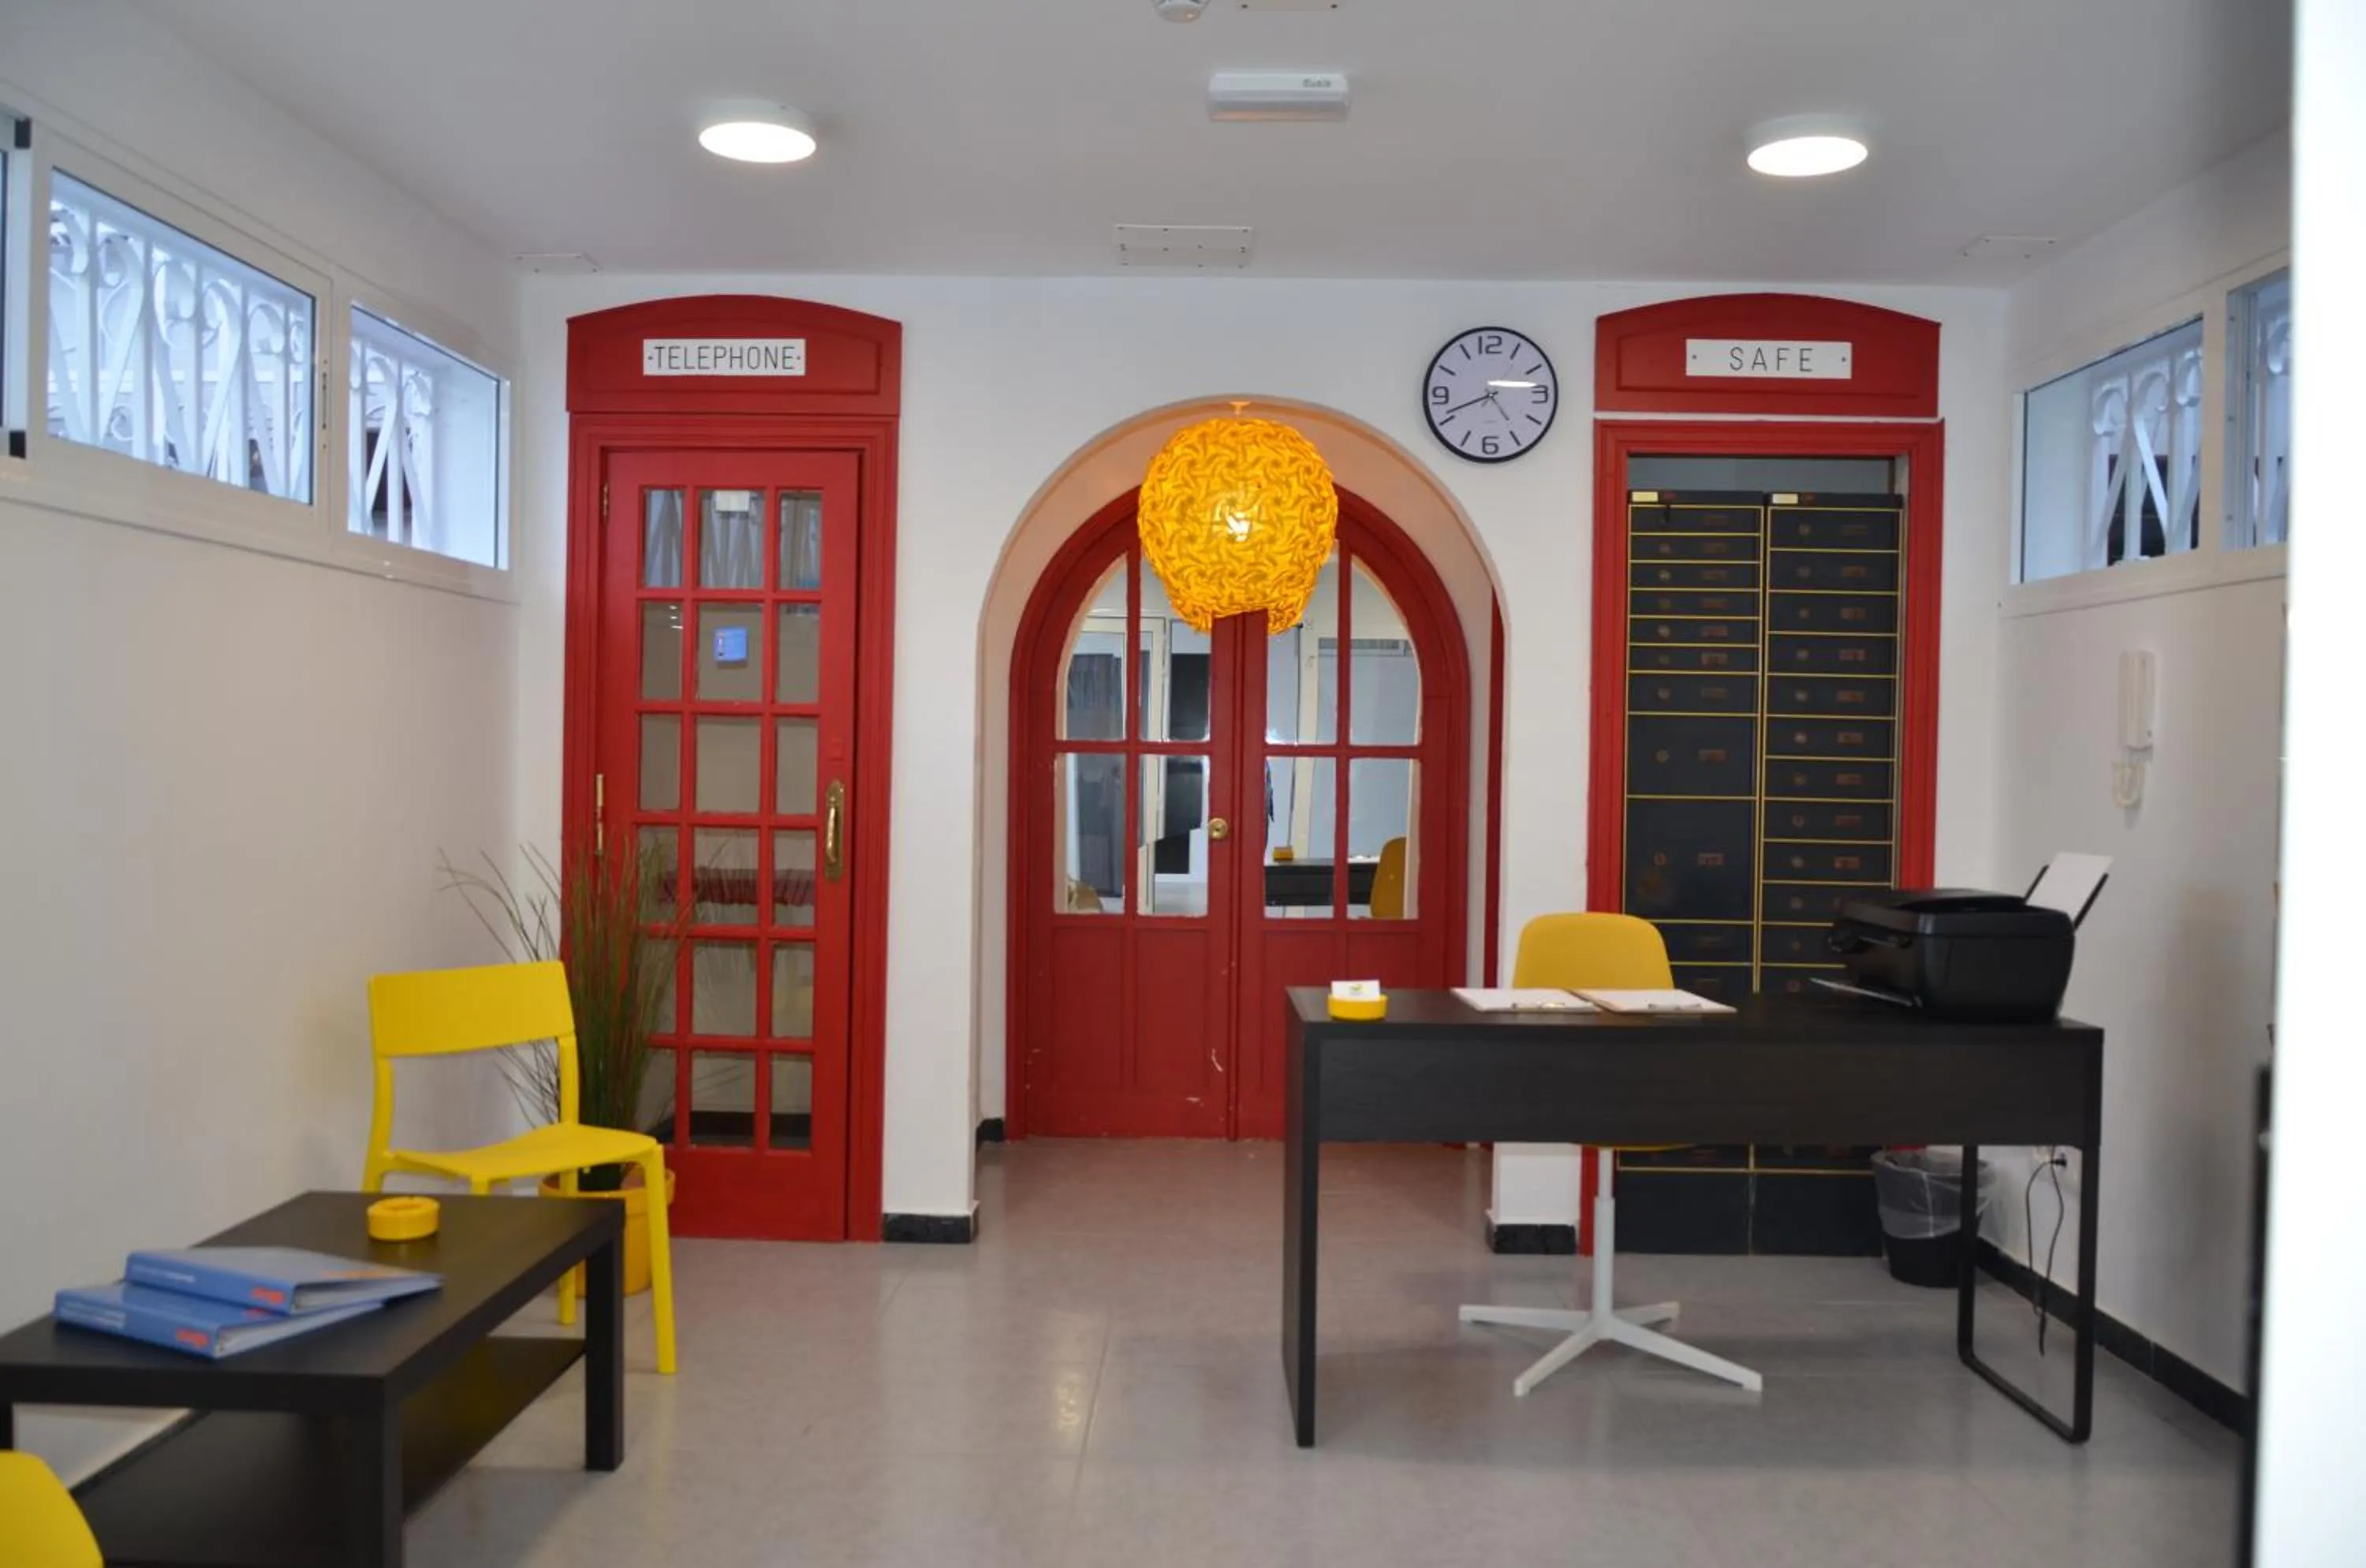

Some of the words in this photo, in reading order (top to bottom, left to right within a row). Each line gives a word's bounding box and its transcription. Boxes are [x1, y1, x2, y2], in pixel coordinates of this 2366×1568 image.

[1478, 335, 1502, 354] 12
[653, 345, 796, 370] TELEPHONE
[1730, 346, 1813, 372] SAFE
[1431, 386, 1450, 405] 9
[1531, 384, 1549, 404] 3
[1482, 436, 1499, 454] 6
